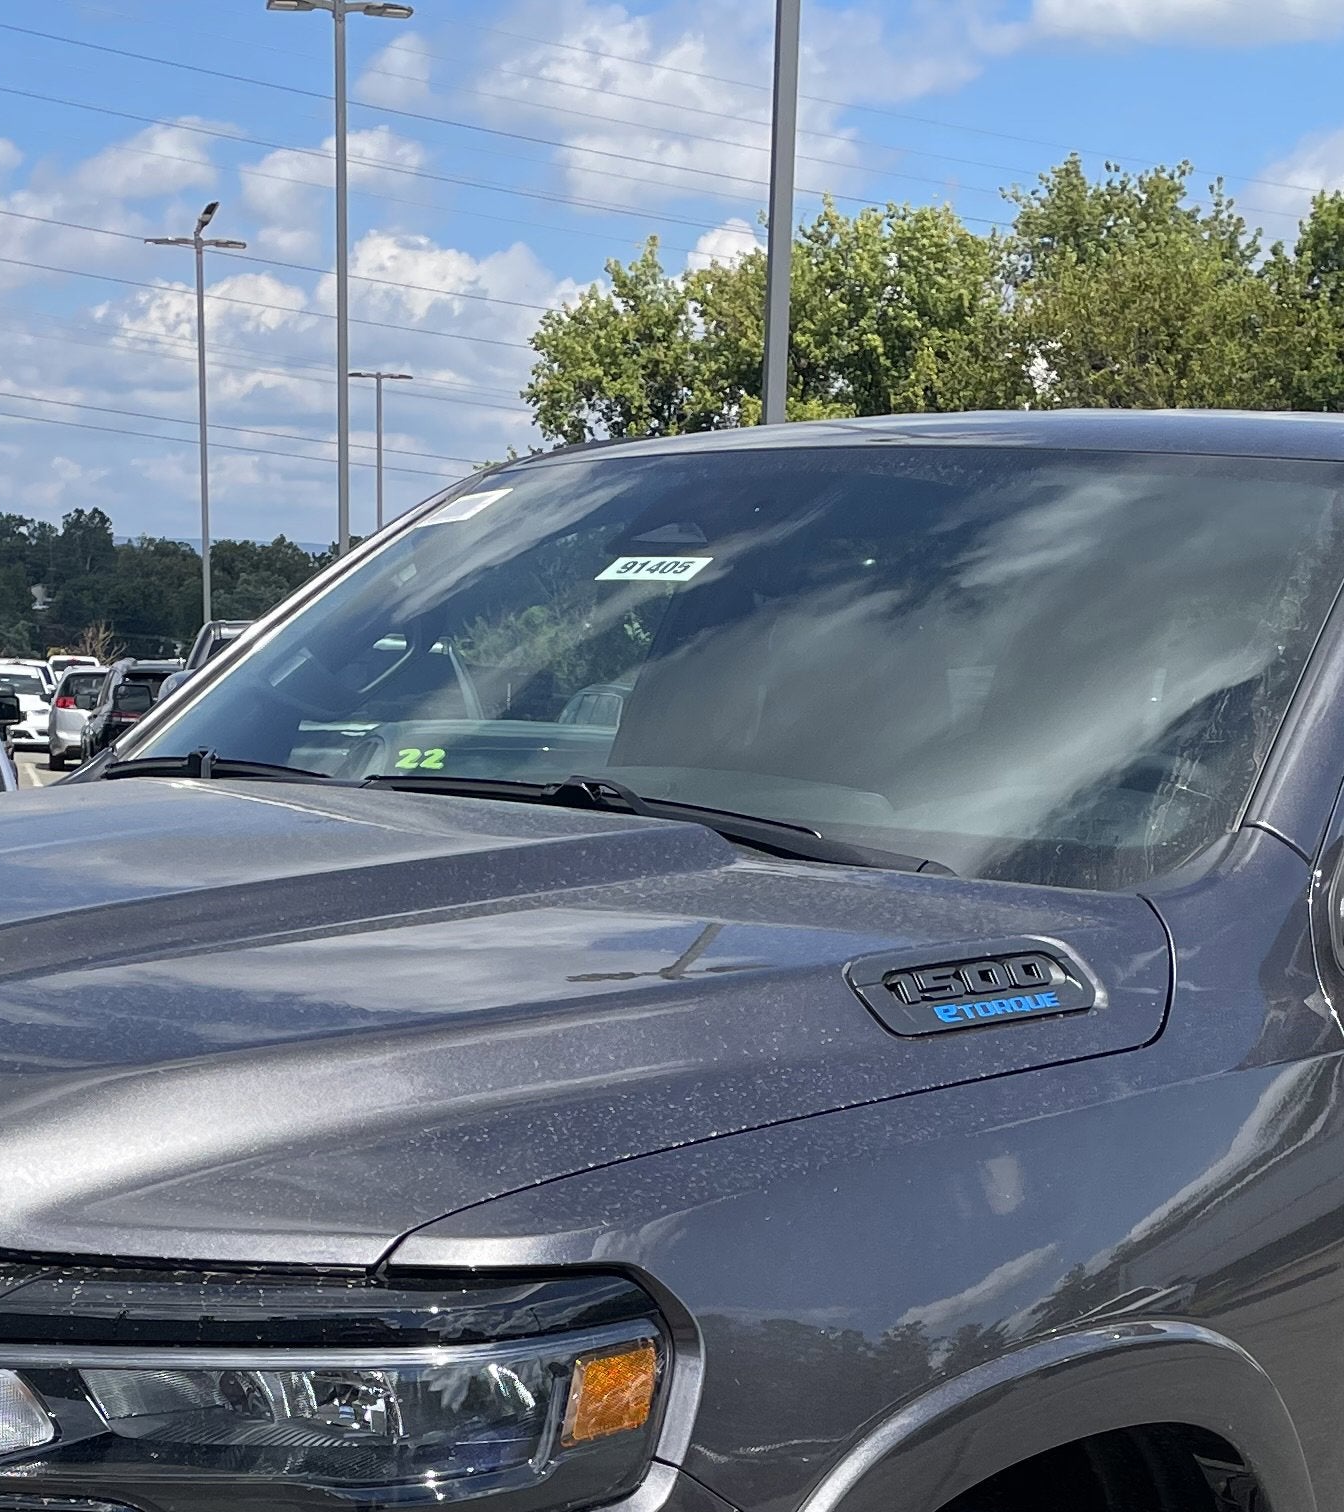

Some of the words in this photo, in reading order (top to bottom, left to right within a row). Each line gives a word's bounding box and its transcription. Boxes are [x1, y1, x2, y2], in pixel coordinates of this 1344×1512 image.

[615, 560, 696, 575] 91405
[394, 748, 447, 770] 22
[887, 954, 1055, 1006] 1500
